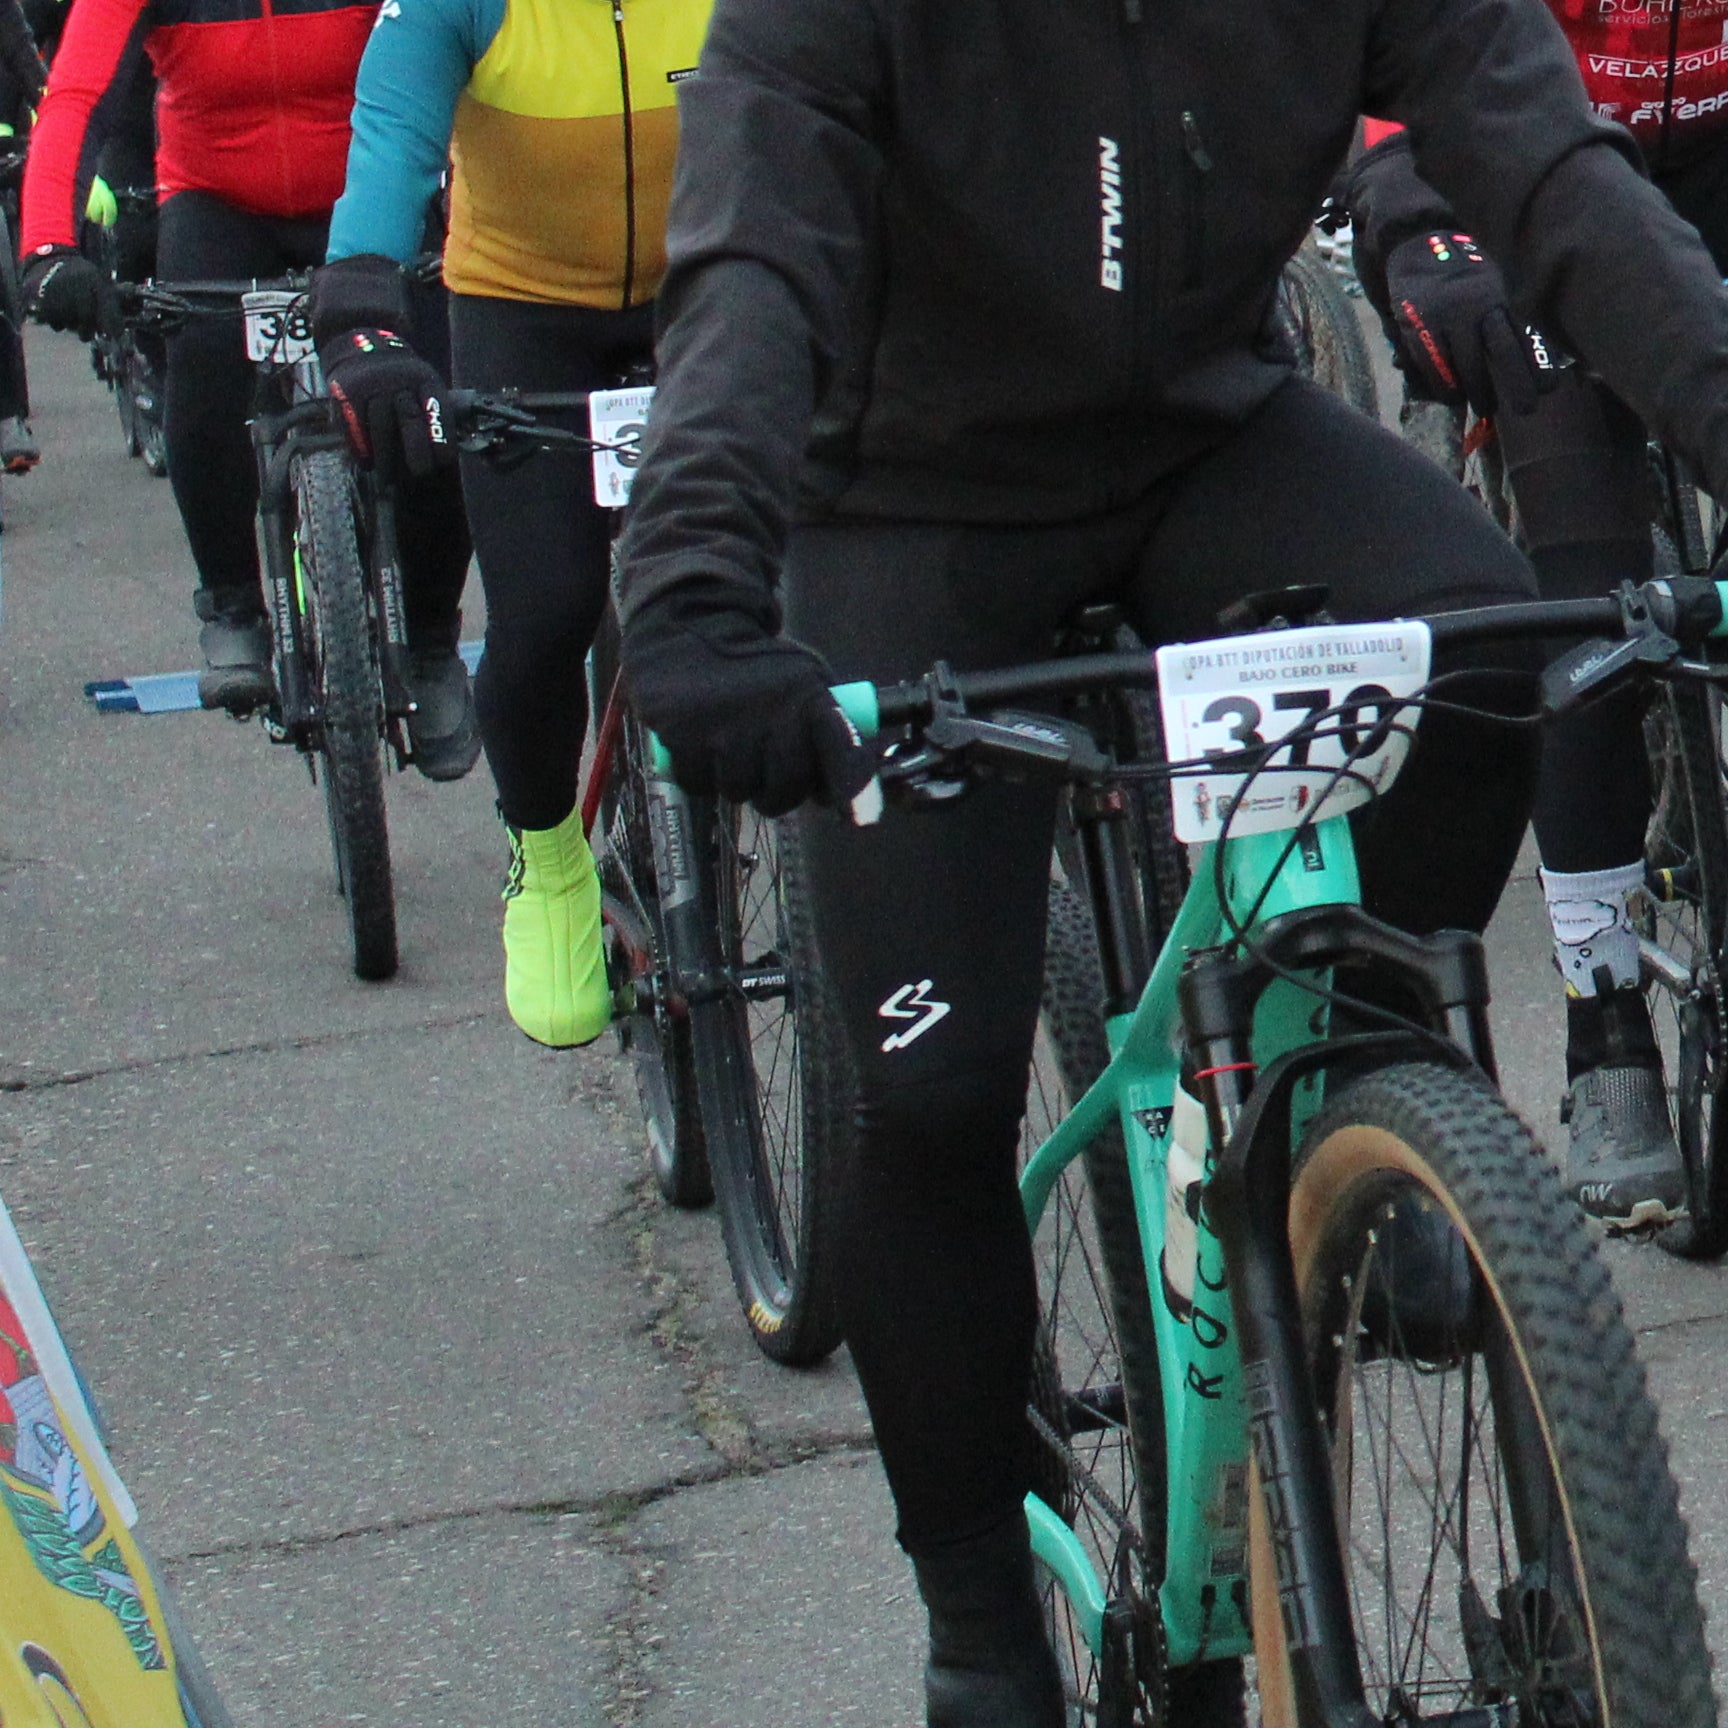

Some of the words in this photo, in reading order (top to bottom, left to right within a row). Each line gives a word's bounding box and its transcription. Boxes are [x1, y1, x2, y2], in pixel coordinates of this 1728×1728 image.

[1239, 668, 1277, 683] BAJO
[1281, 664, 1322, 680] CERO
[1326, 660, 1359, 676] BIKE
[1201, 683, 1394, 774] 370
